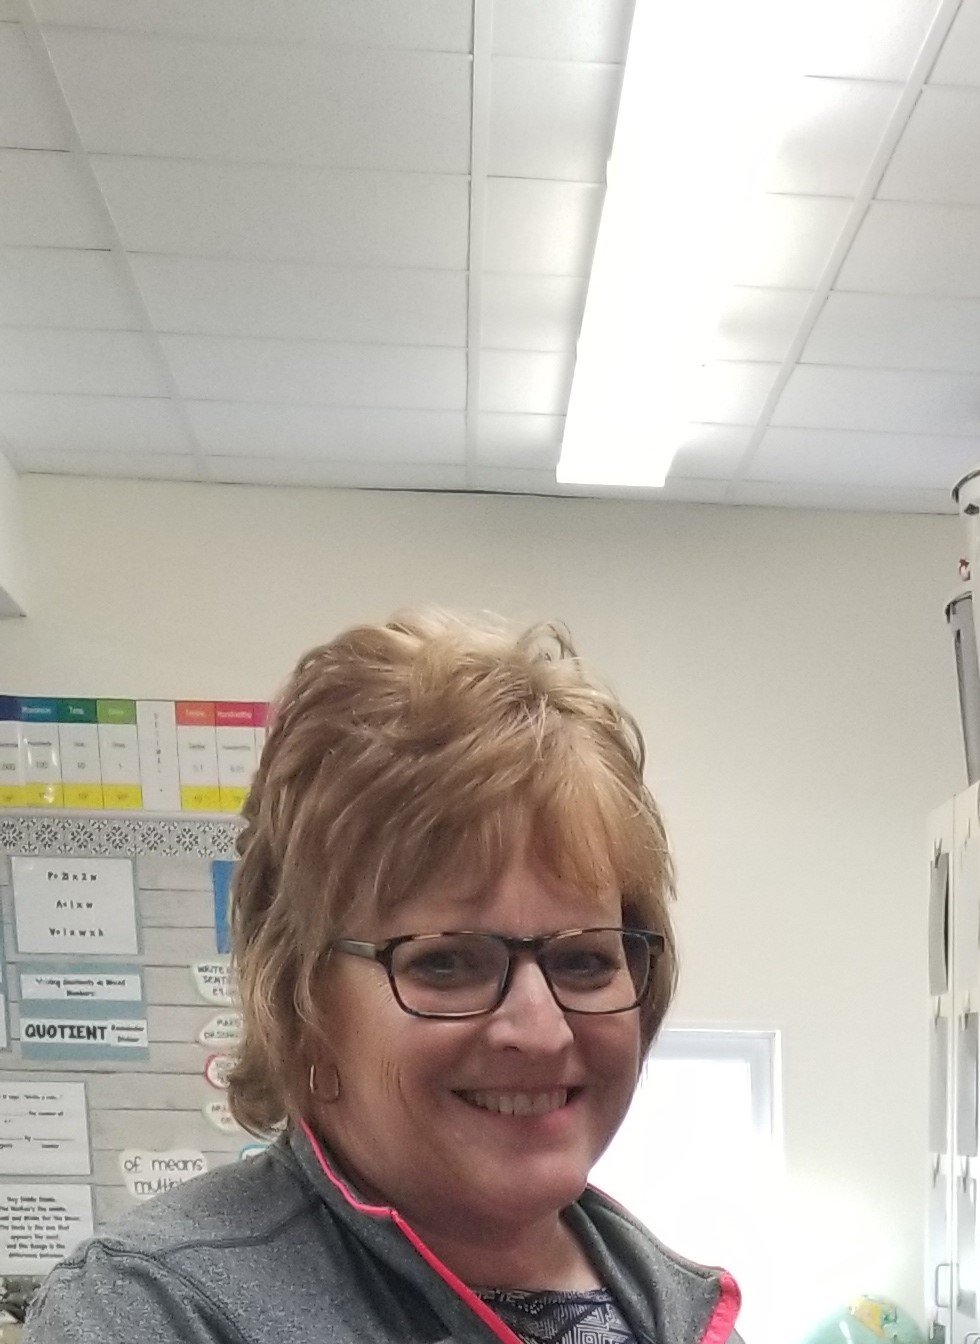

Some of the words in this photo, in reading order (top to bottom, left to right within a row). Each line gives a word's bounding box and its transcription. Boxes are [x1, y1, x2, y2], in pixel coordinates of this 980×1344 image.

[25, 1023, 108, 1041] QUOTIENT
[124, 1156, 141, 1172] of
[151, 1158, 203, 1172] means
